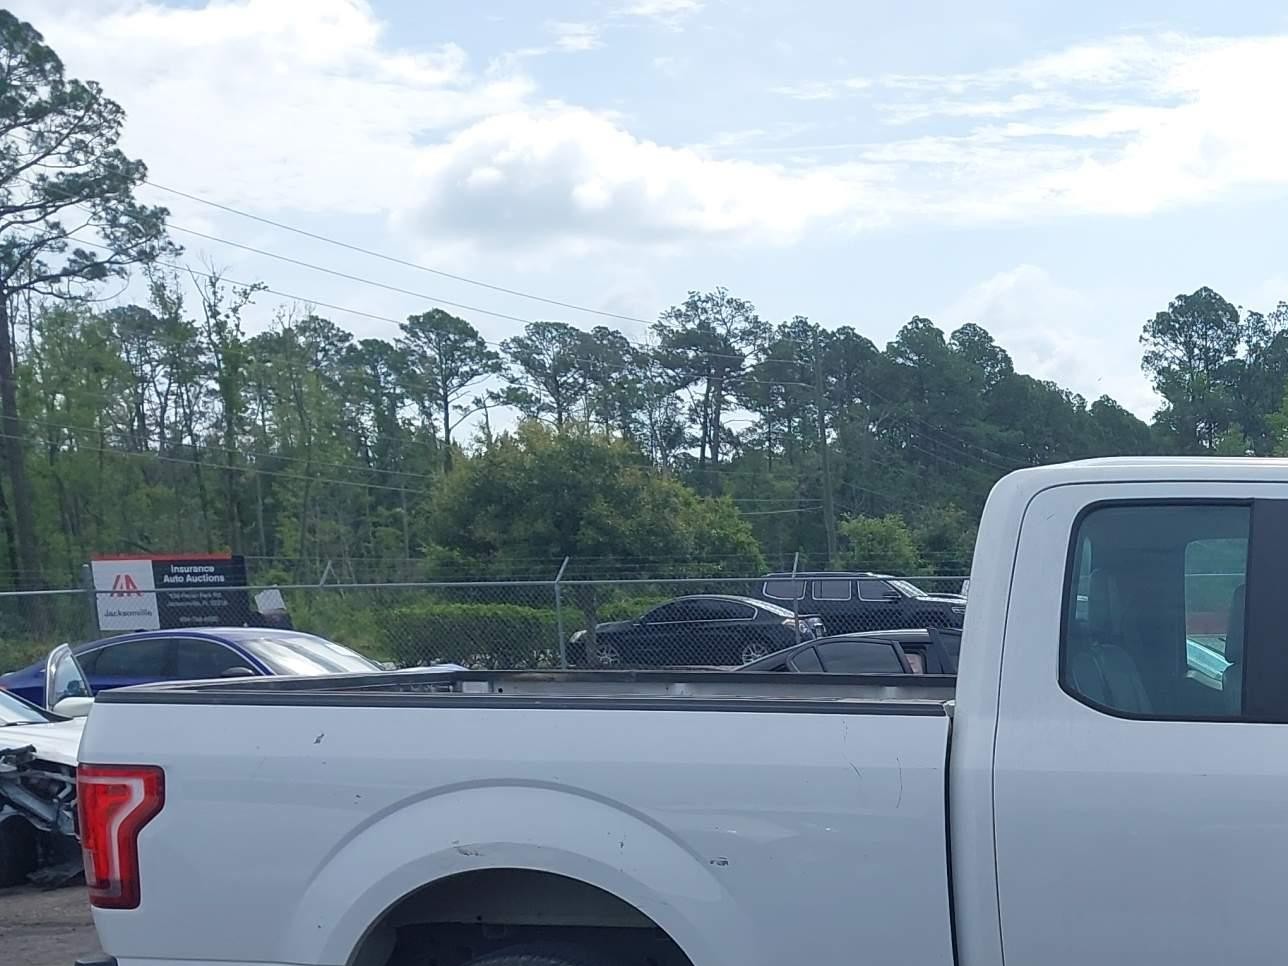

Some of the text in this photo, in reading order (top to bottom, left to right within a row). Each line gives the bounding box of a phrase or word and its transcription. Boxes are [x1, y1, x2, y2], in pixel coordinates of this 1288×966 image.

[170, 564, 215, 573] Insurance
[163, 573, 225, 583] Auto Auctions
